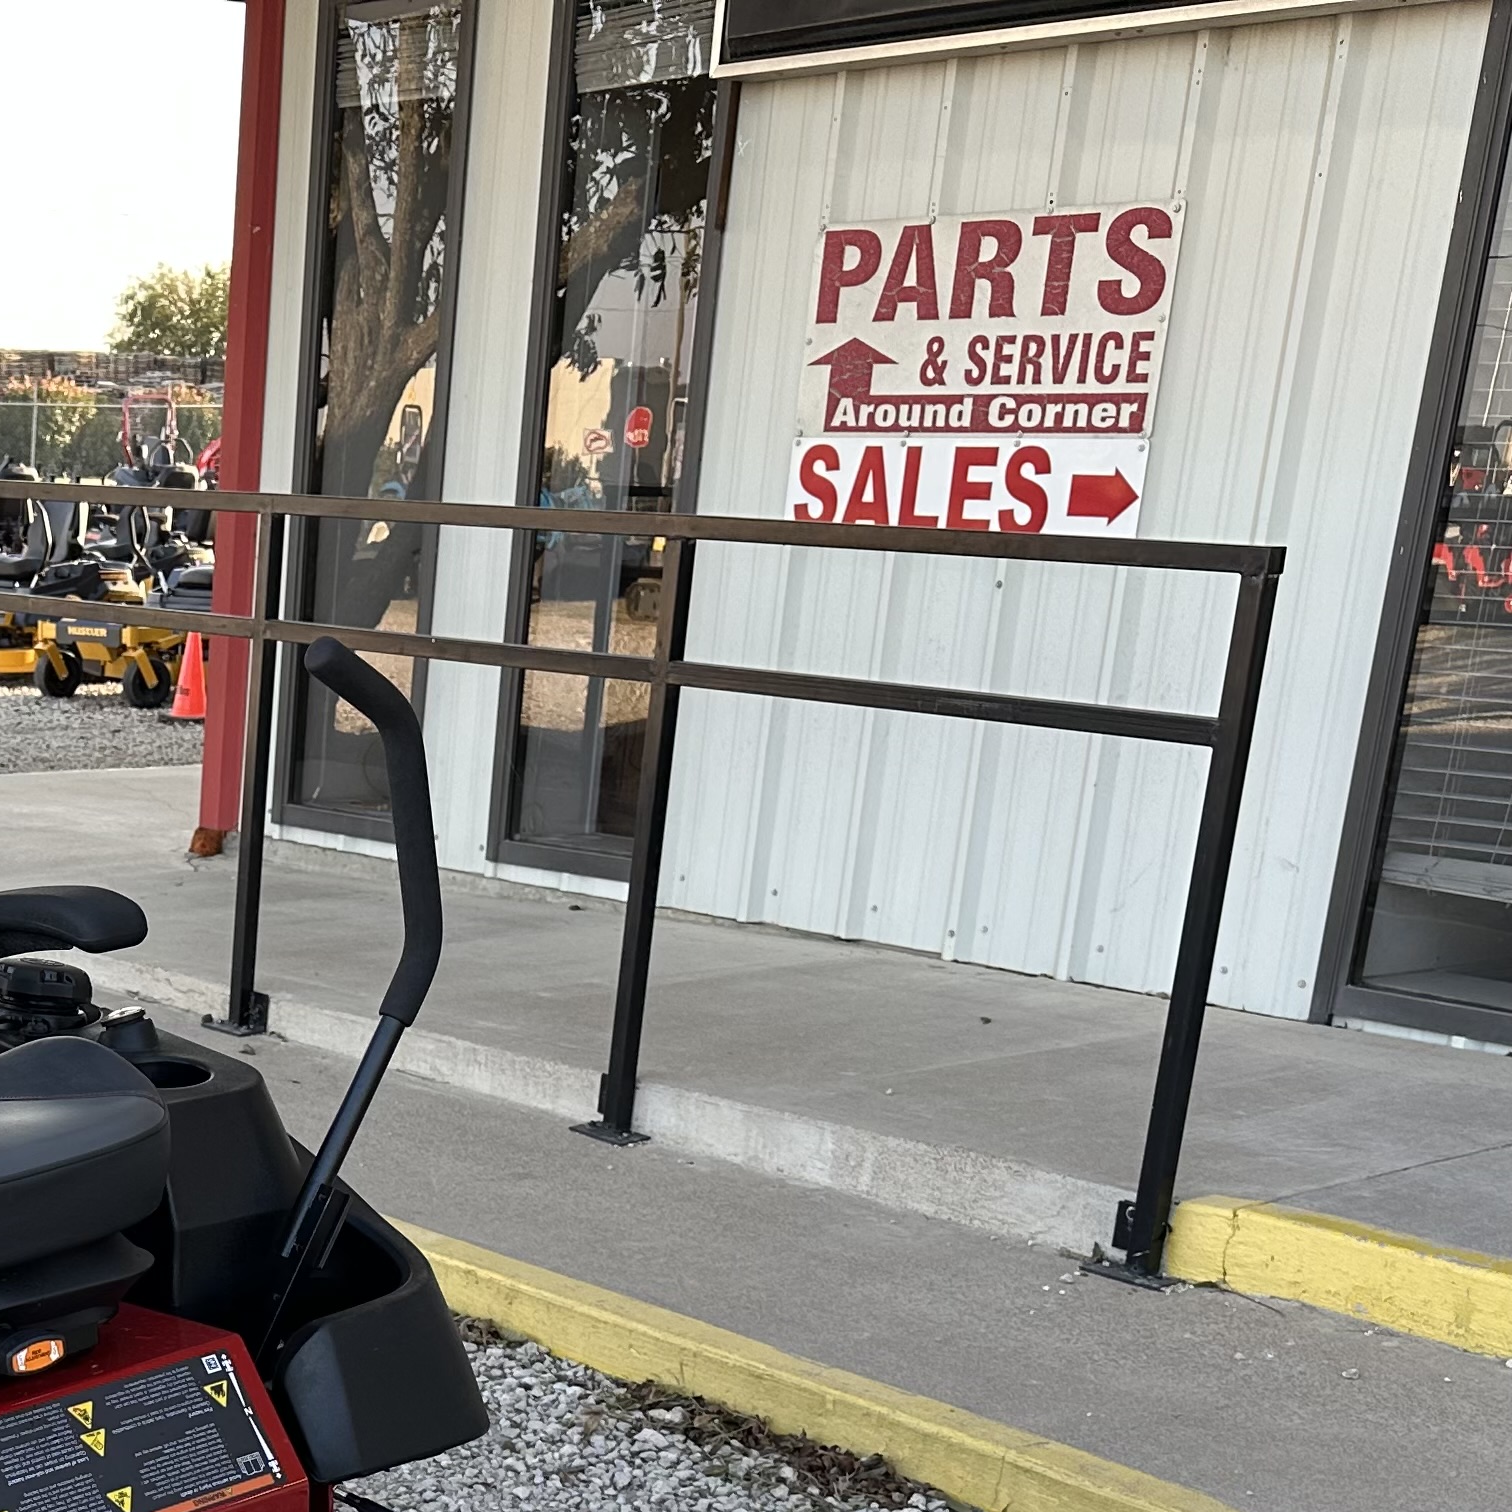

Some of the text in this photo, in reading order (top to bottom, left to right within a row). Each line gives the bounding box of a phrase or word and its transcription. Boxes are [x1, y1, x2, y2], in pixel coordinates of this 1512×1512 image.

[815, 206, 1173, 325] PARTS
[919, 331, 1156, 387] & SERVICE
[830, 396, 1140, 428] Around Corner
[794, 443, 1052, 534] SALES
